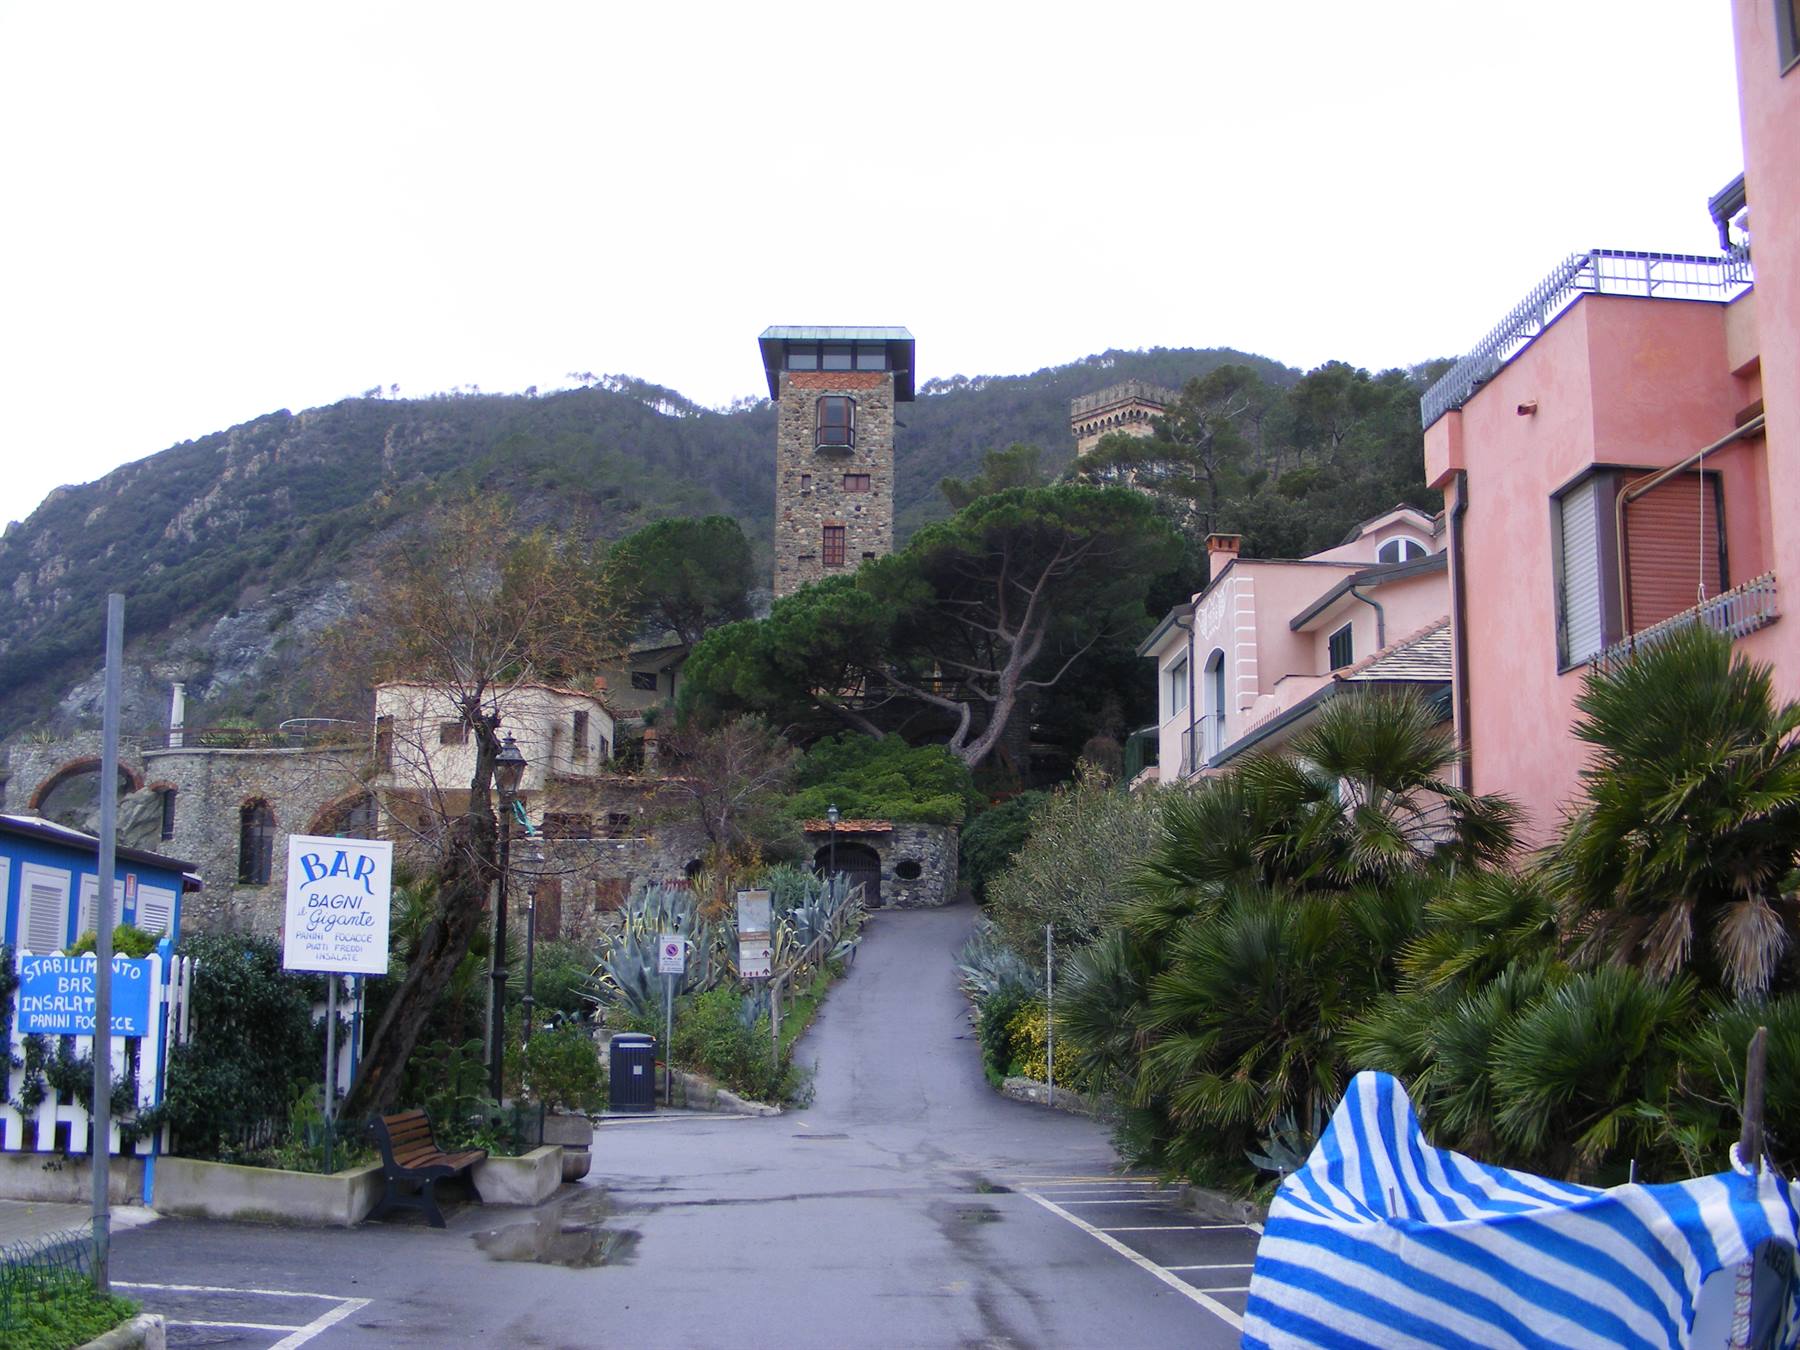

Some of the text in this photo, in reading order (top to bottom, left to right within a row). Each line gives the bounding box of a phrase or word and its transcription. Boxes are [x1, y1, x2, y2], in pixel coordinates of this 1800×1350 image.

[300, 850, 376, 895] BAR
[308, 893, 363, 909] BAGNI
[307, 909, 375, 932] Gigante
[295, 931, 374, 944] PANINI FOCACCE
[23, 959, 141, 984] STABILIMNTO
[58, 977, 94, 994] BAR
[22, 994, 97, 1012] INSALAT
[30, 1014, 135, 1031] PANINI FOCCE
